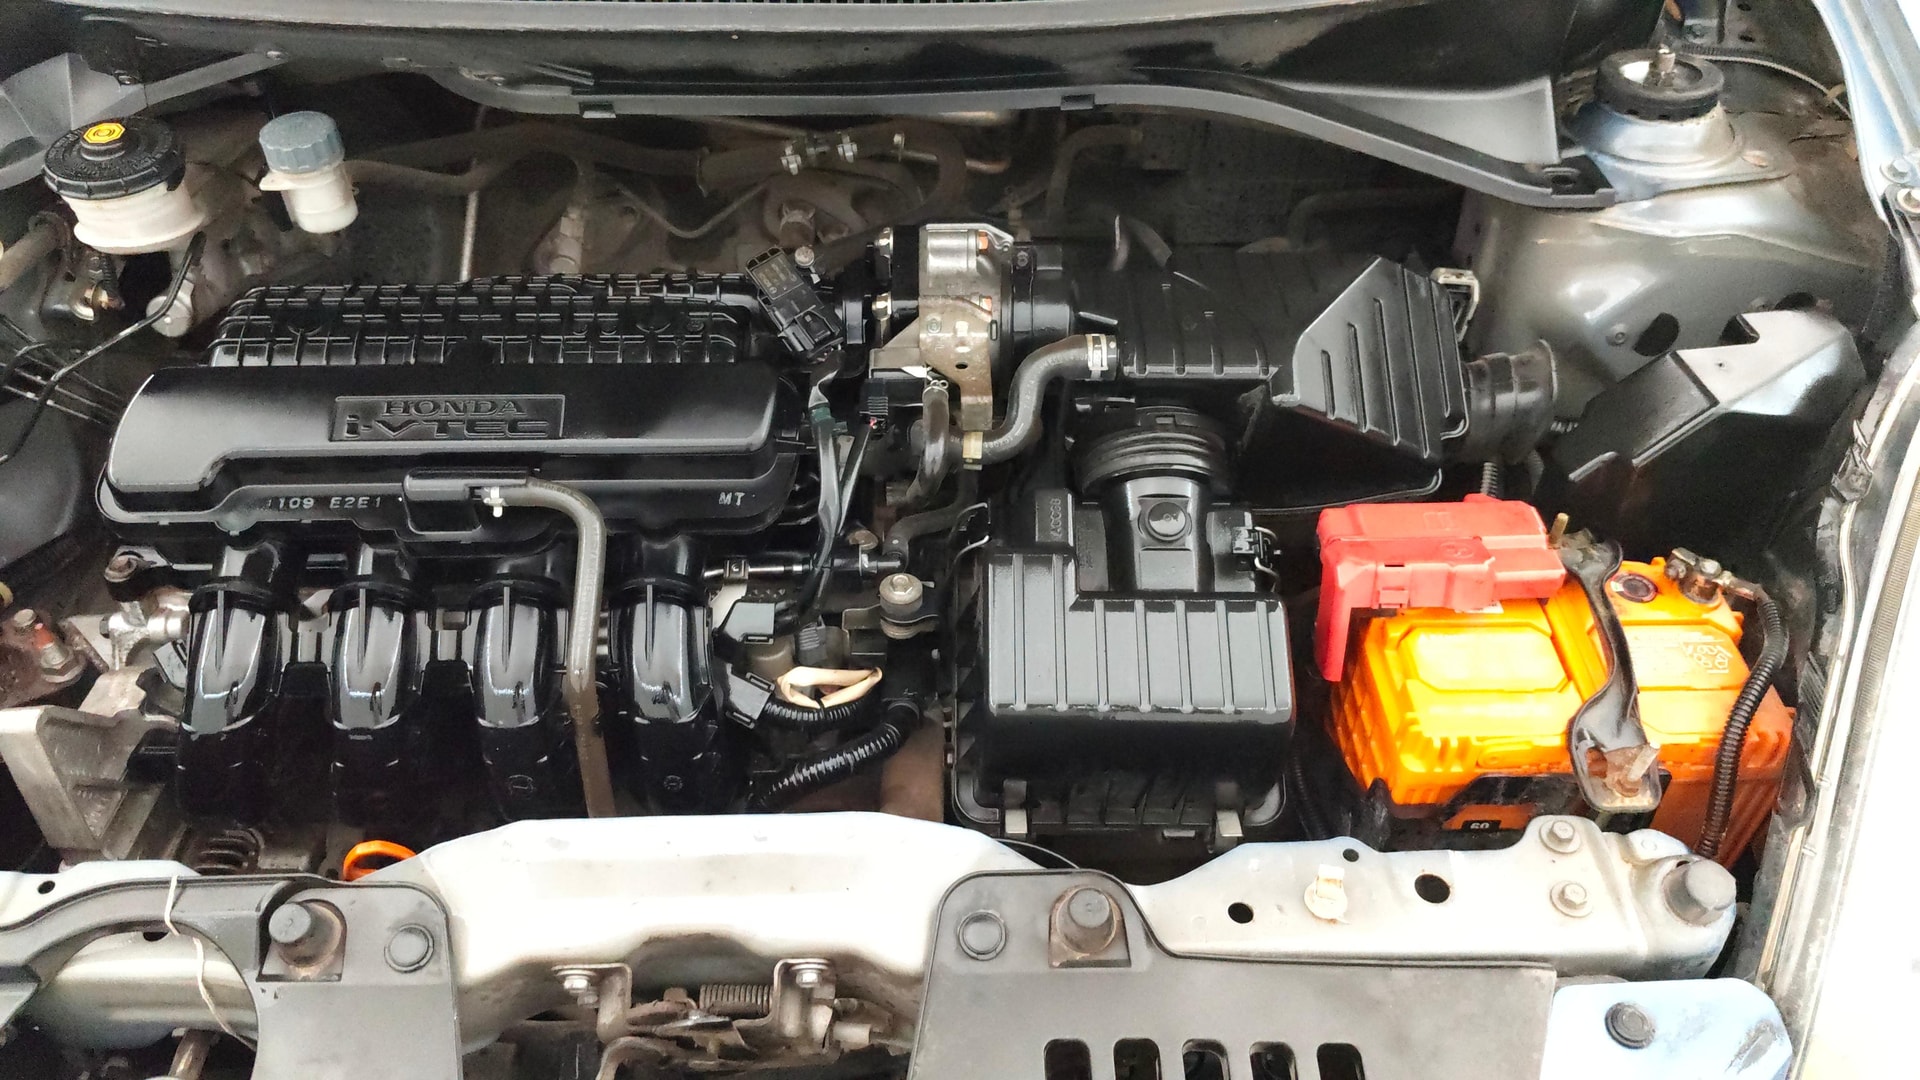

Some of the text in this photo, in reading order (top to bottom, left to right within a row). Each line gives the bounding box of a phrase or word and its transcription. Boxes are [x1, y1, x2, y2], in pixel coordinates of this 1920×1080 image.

[381, 400, 527, 418] HONDA
[344, 414, 549, 439] i-VTEC
[718, 491, 746, 506] MT
